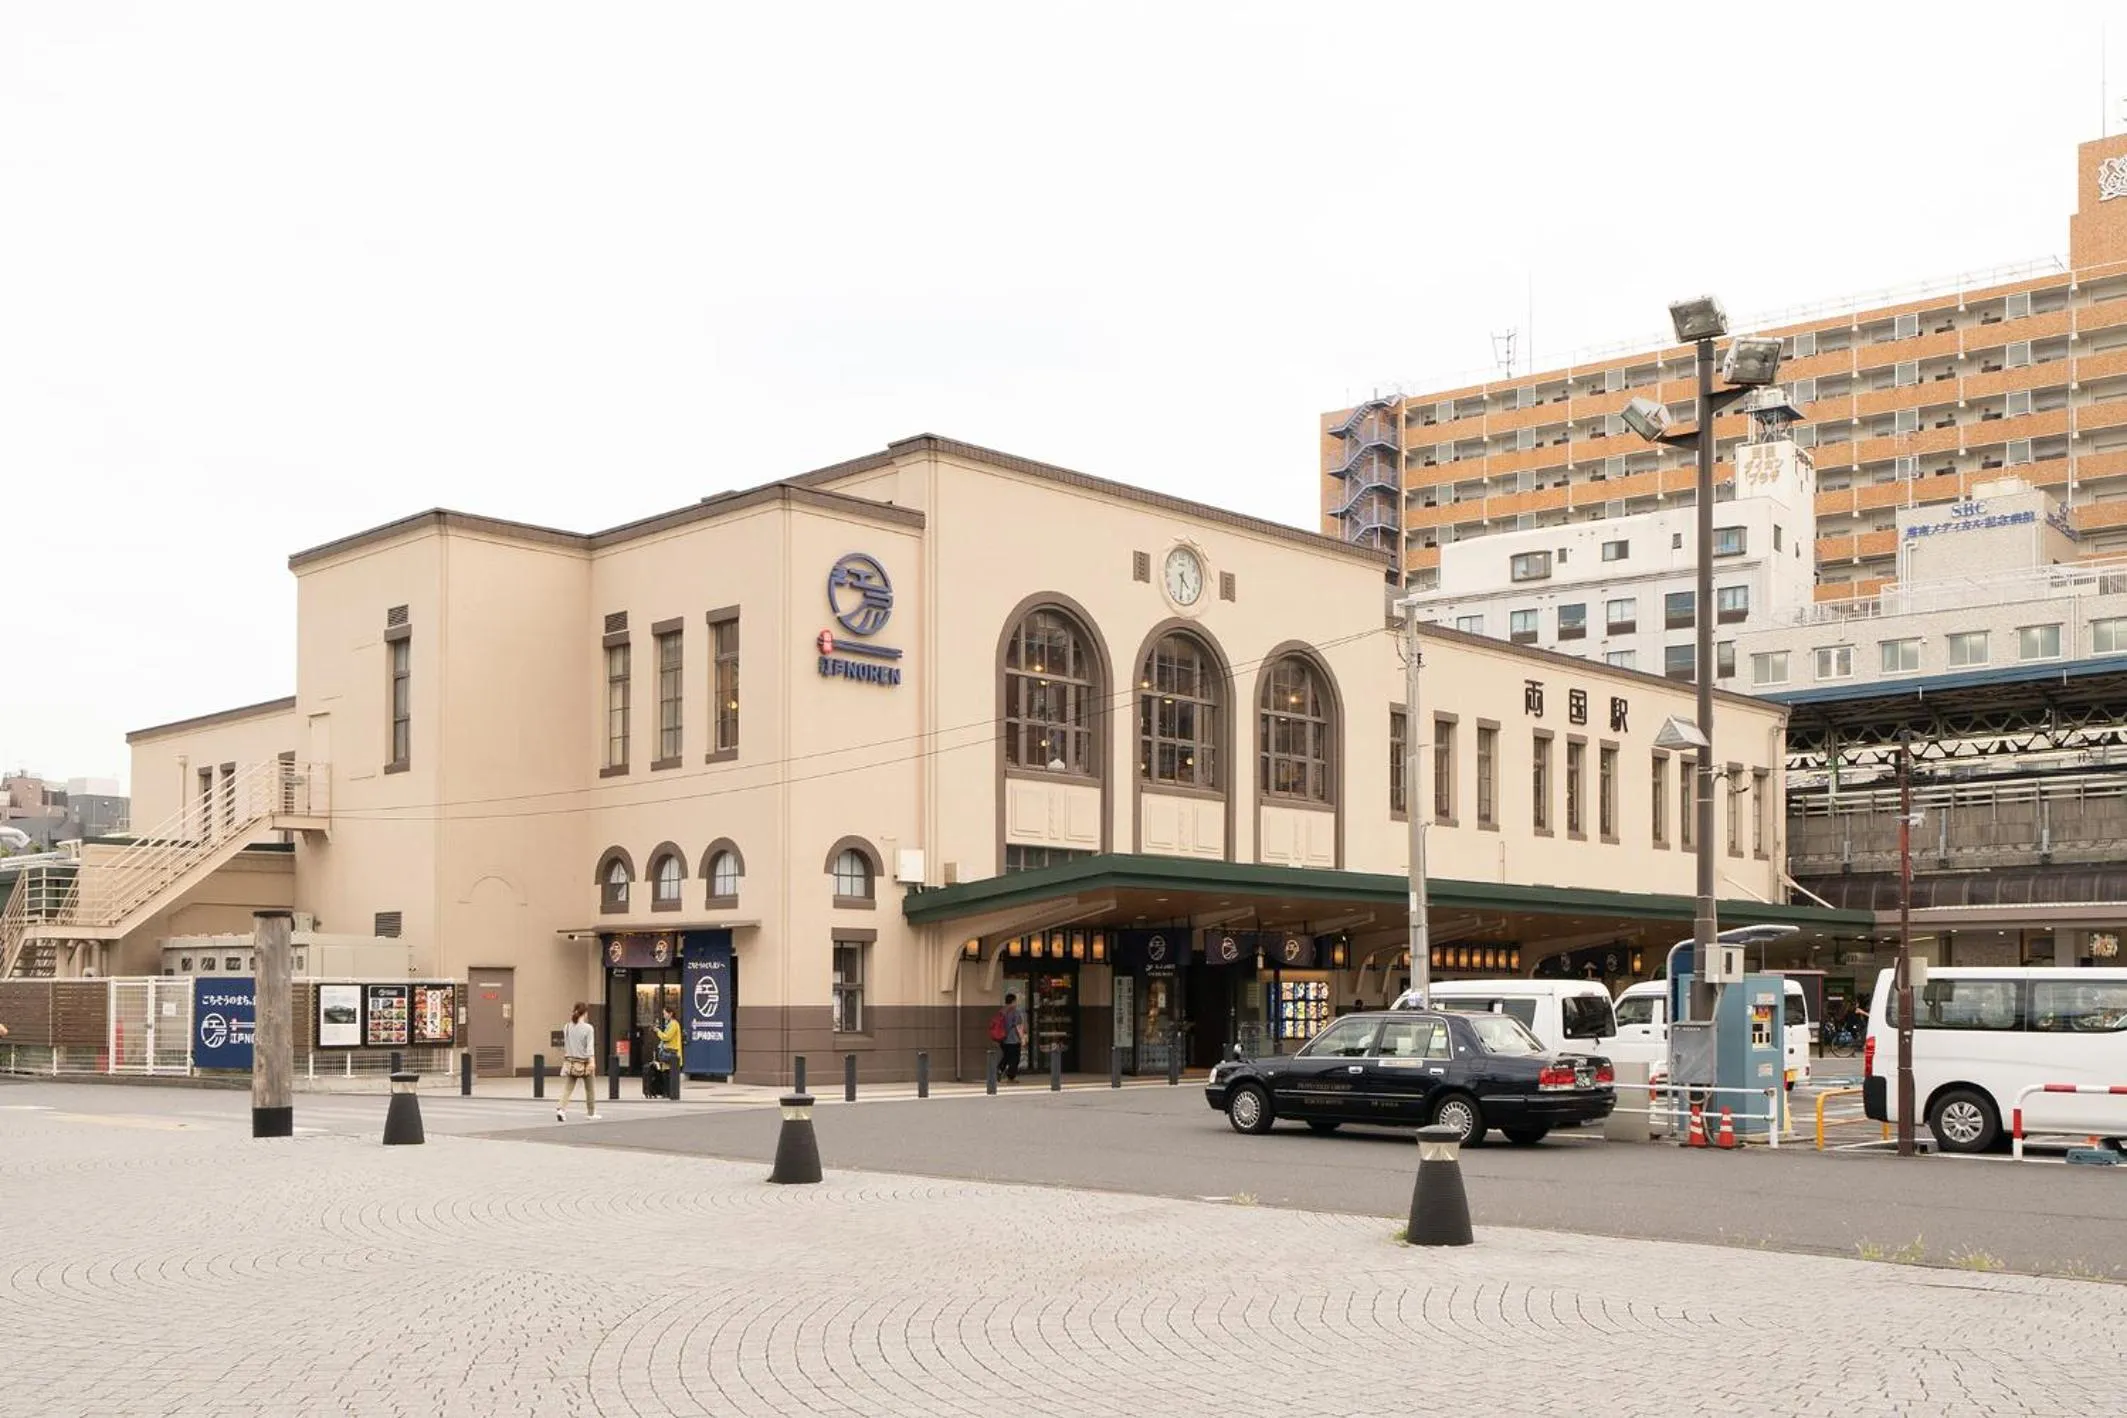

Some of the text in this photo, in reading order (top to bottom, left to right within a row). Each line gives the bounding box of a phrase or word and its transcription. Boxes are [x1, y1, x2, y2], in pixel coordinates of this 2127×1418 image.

[1952, 501, 1987, 517] SBC
[818, 656, 901, 685] 江戸NOREN
[1524, 679, 1629, 733] 両国駅
